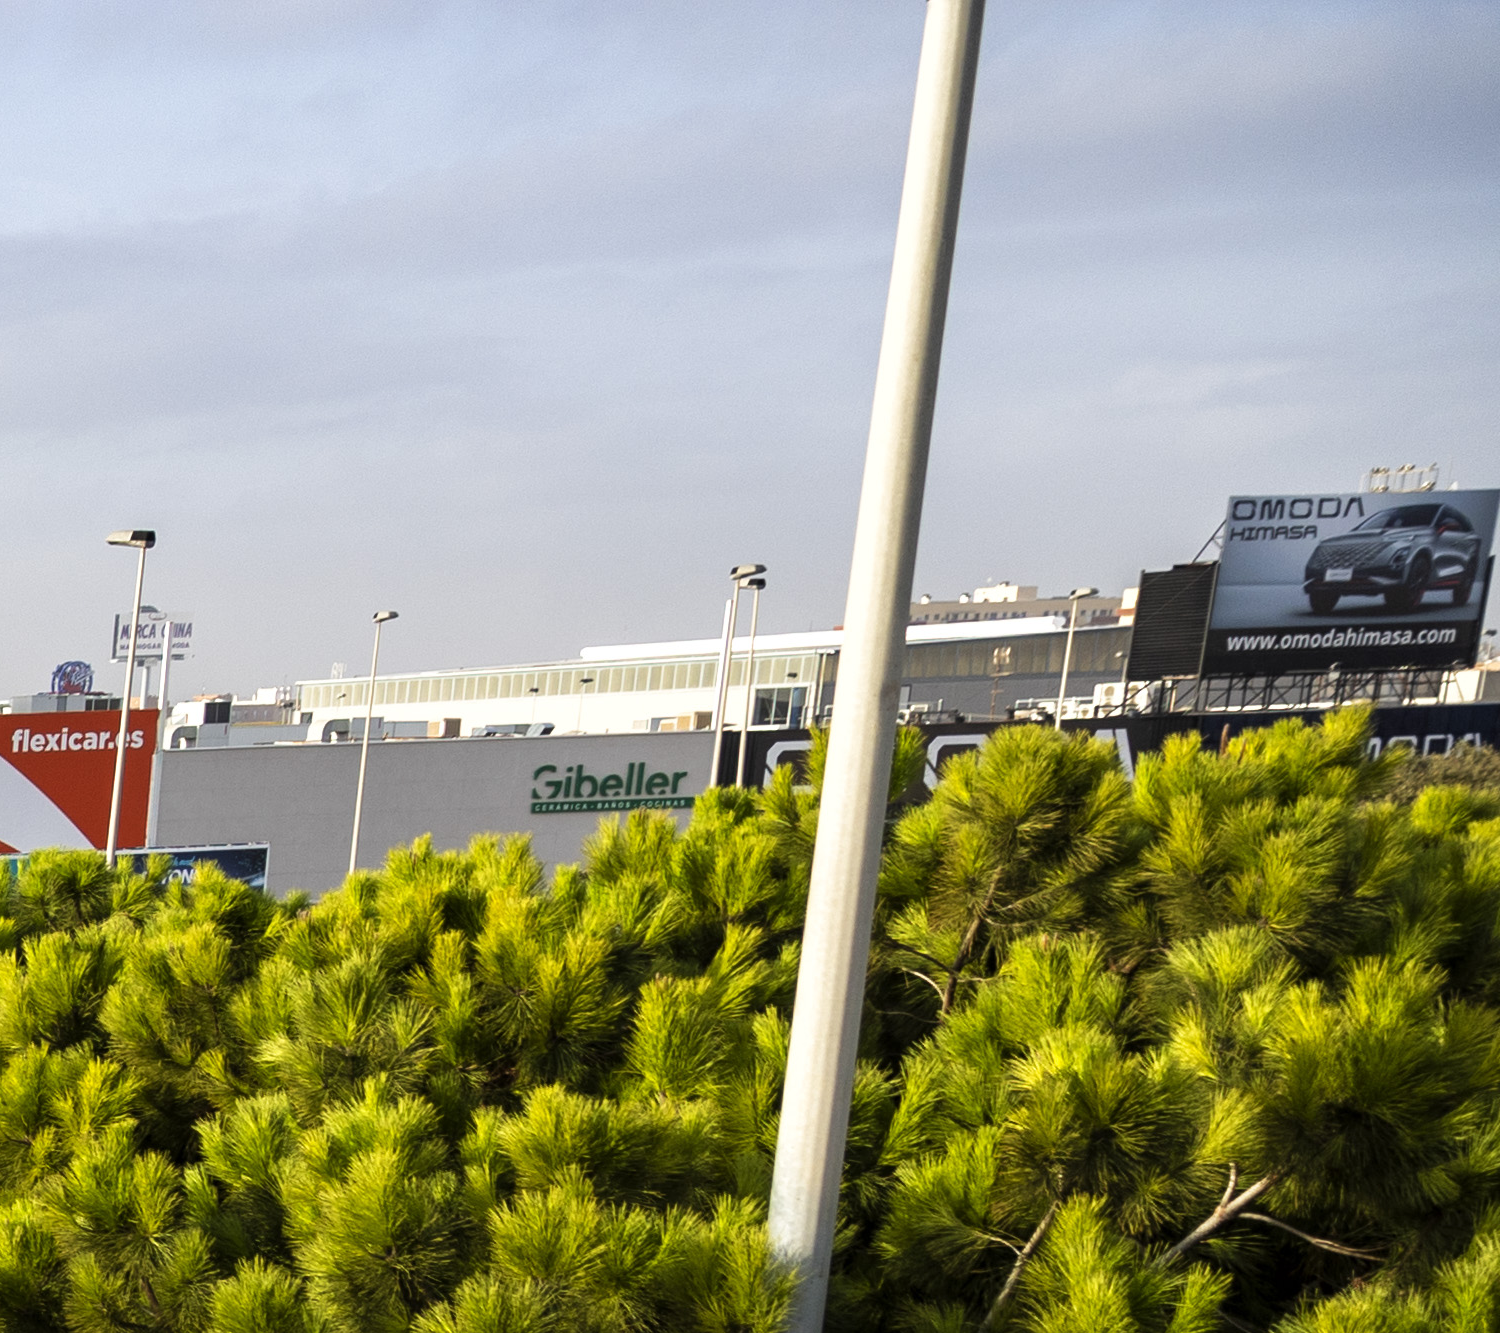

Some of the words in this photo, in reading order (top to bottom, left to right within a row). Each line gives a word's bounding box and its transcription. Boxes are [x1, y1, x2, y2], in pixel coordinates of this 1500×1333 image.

[1232, 497, 1365, 520] OMODA
[1229, 525, 1318, 541] HIMASA
[1227, 628, 1457, 651] www.omodahimasa.com
[531, 762, 688, 799] Gibeller
